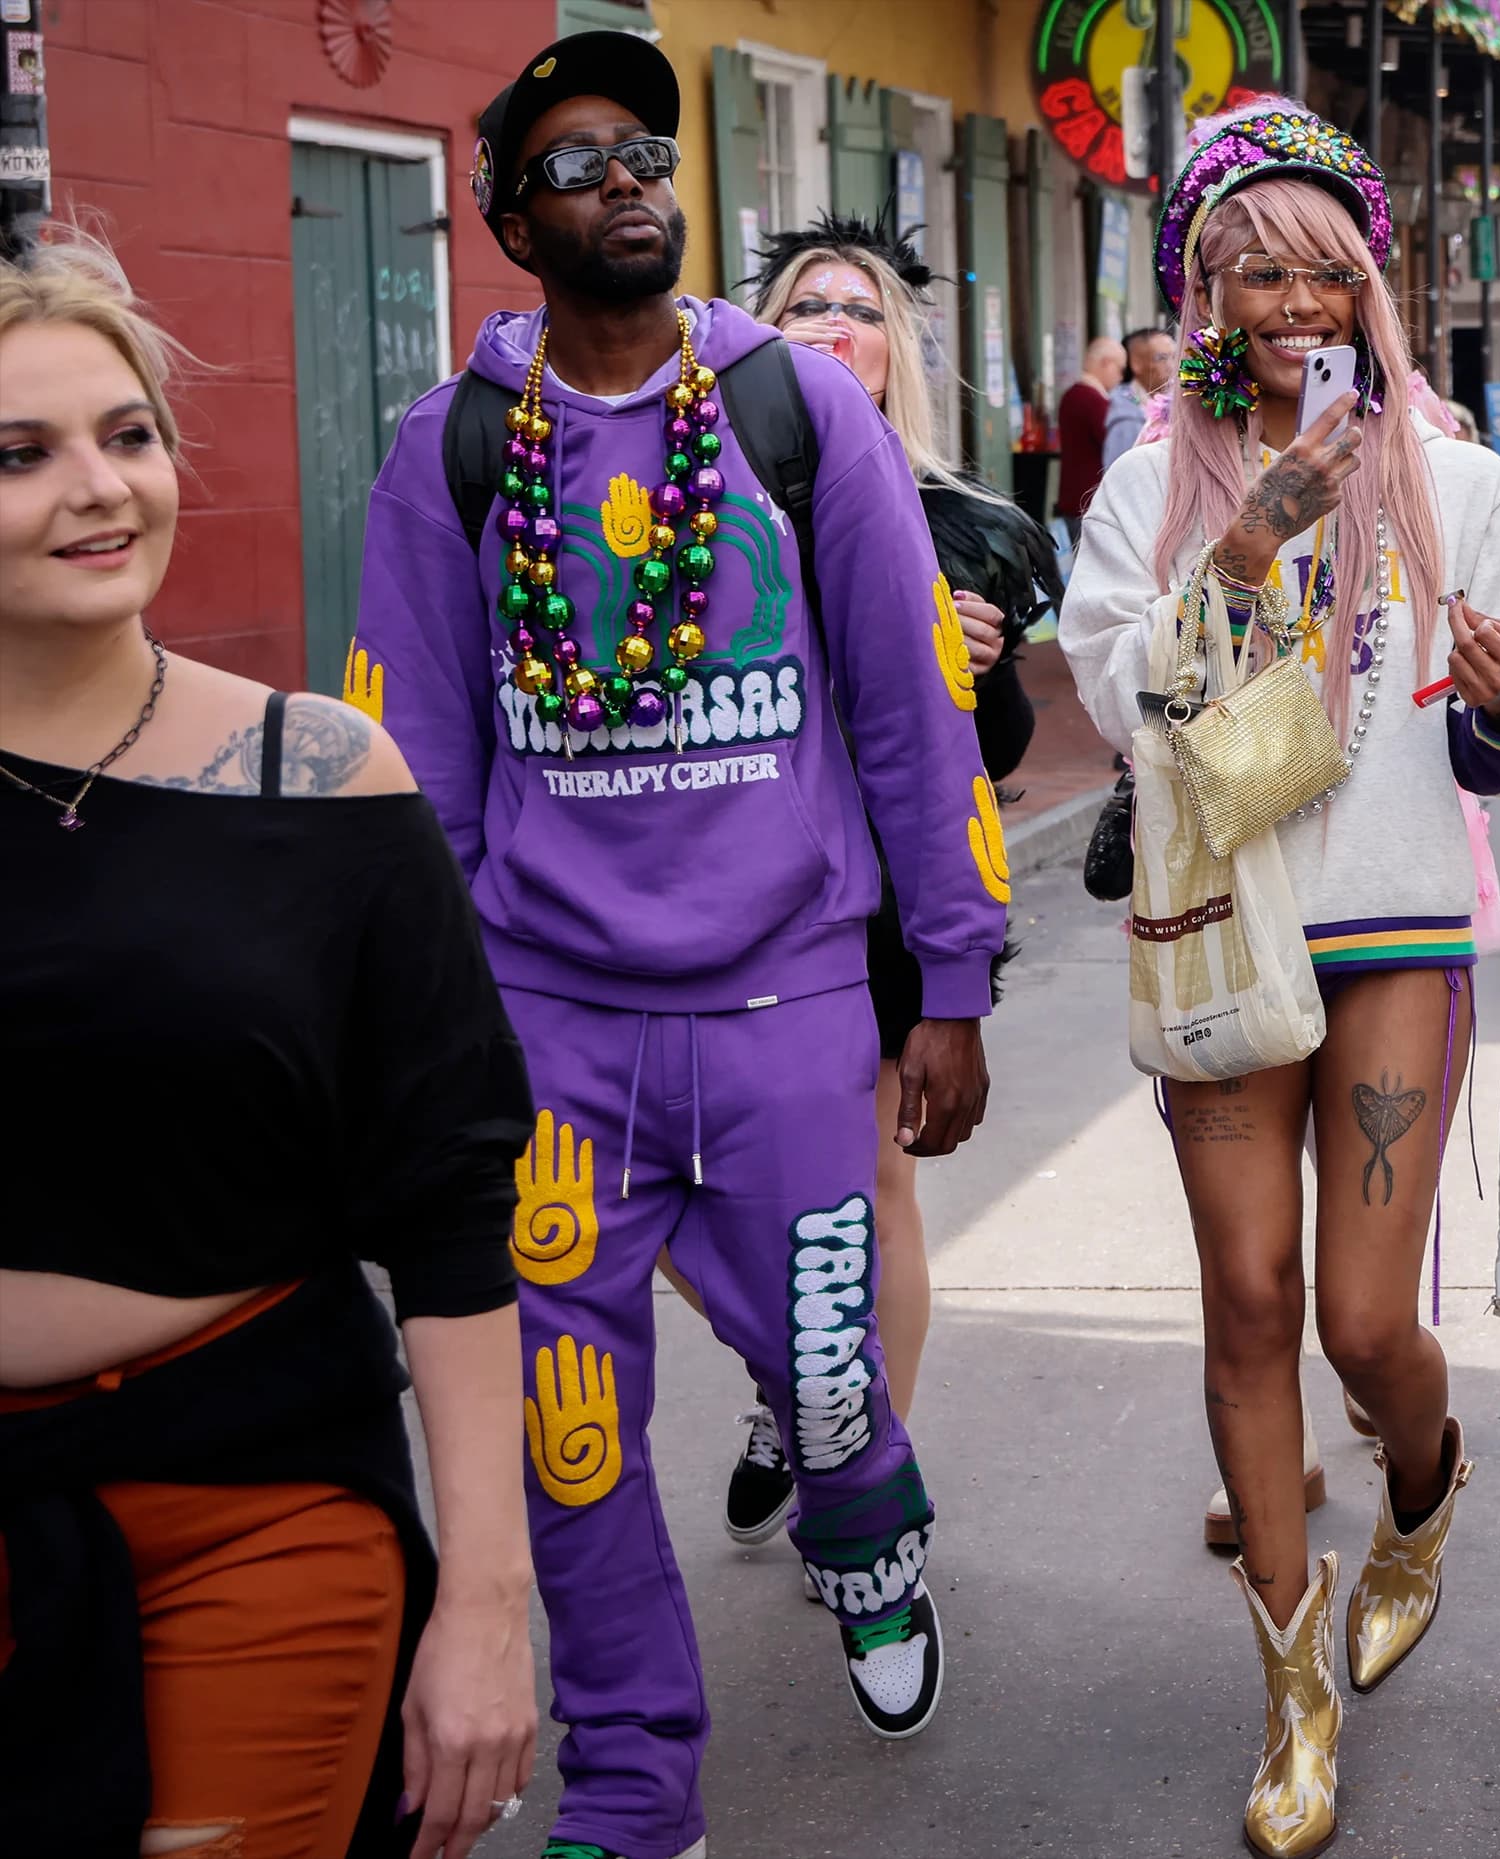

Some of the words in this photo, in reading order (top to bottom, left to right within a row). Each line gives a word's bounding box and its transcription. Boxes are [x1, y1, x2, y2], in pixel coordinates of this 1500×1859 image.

[499, 667, 802, 753] VASAS
[543, 764, 668, 799] THERAPY
[670, 753, 780, 791] CENTER
[1205, 902, 1233, 915] PIRIT
[795, 1197, 872, 1471] VALABAA
